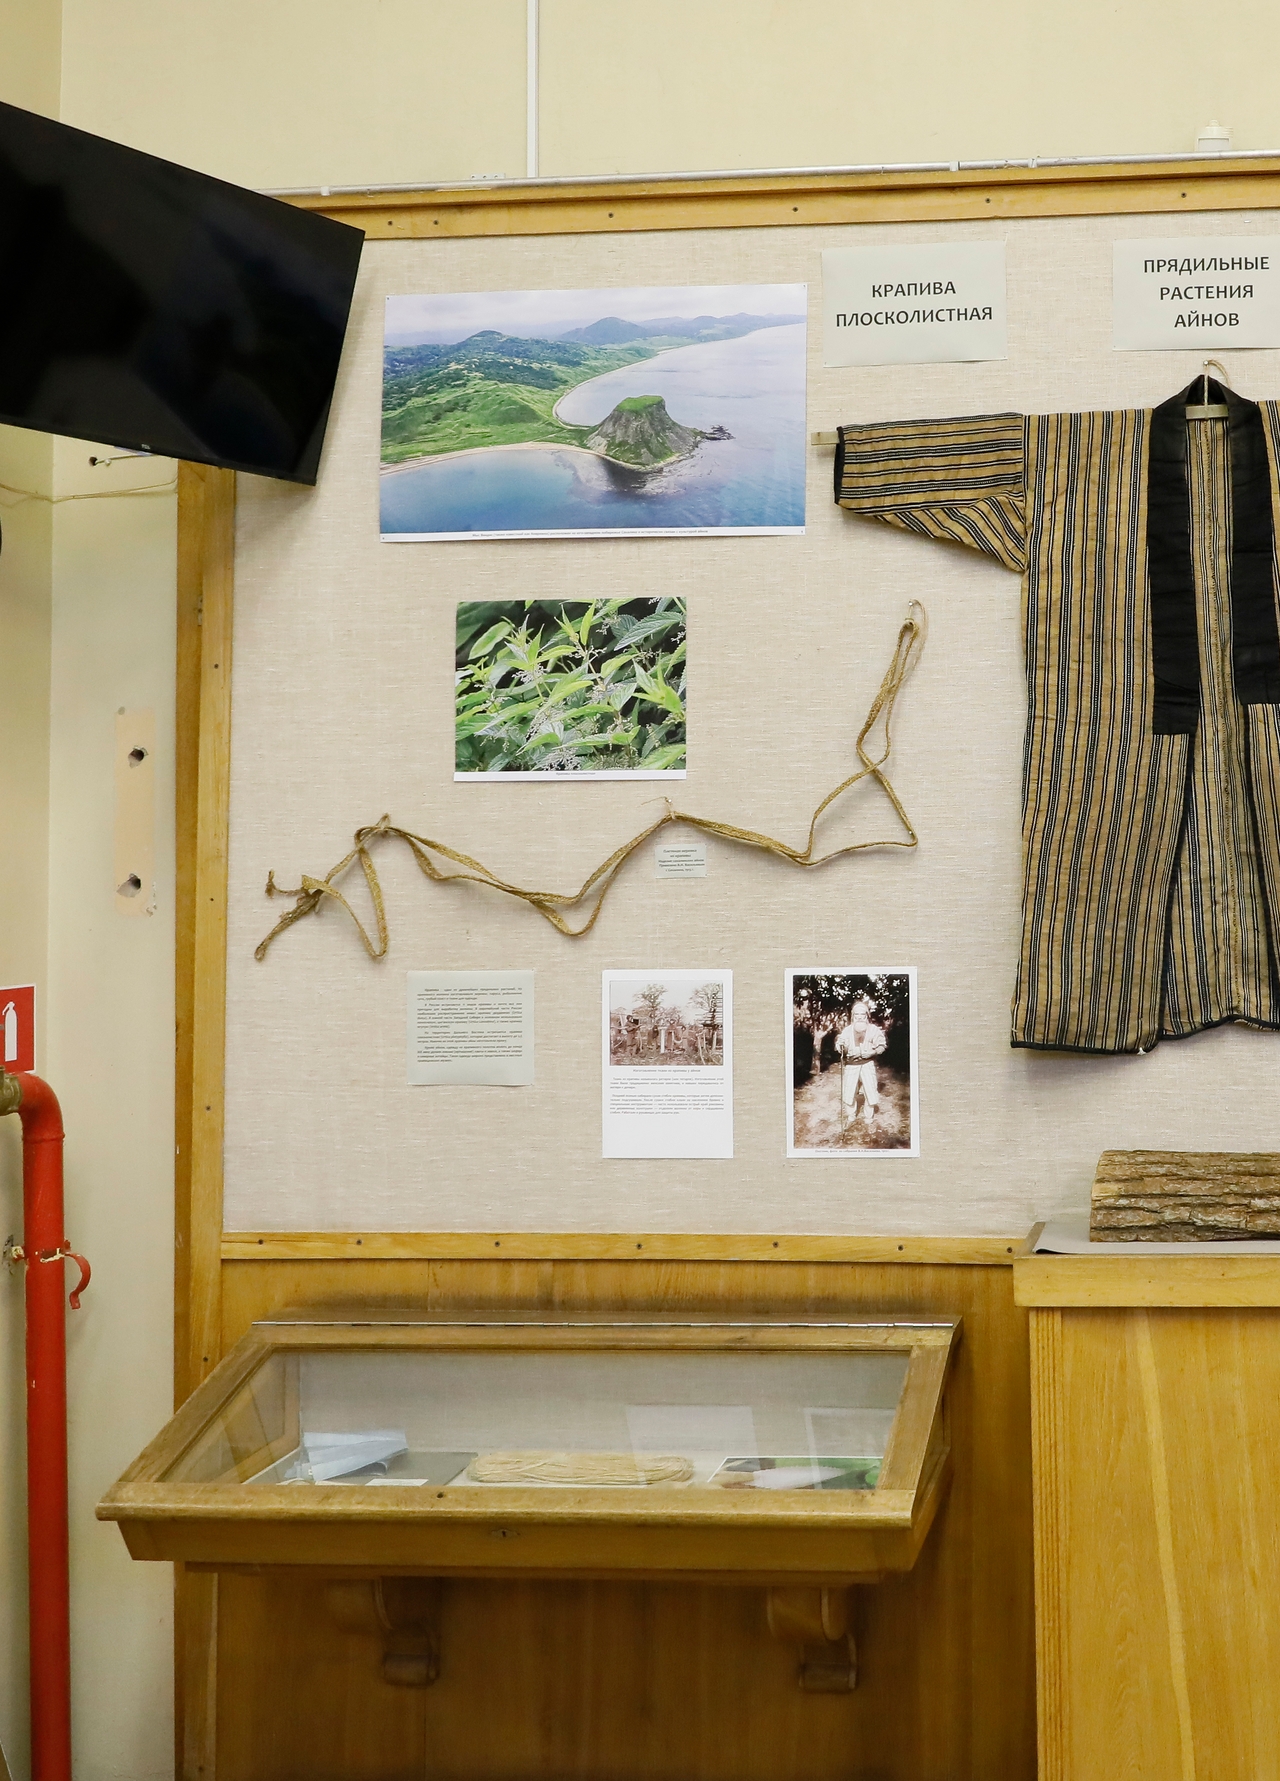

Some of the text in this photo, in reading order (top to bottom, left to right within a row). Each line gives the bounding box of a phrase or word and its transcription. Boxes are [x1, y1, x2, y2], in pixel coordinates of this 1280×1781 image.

[1144, 256, 1270, 276] ПРЯДИЛЬНЫЕ
[872, 281, 956, 298] КРАПИВА
[1159, 284, 1254, 300] РАСТЕНИЯ
[836, 307, 993, 327] ПЛОСКОЛИСТНАЯ
[1174, 310, 1240, 328] АЙНОВ
